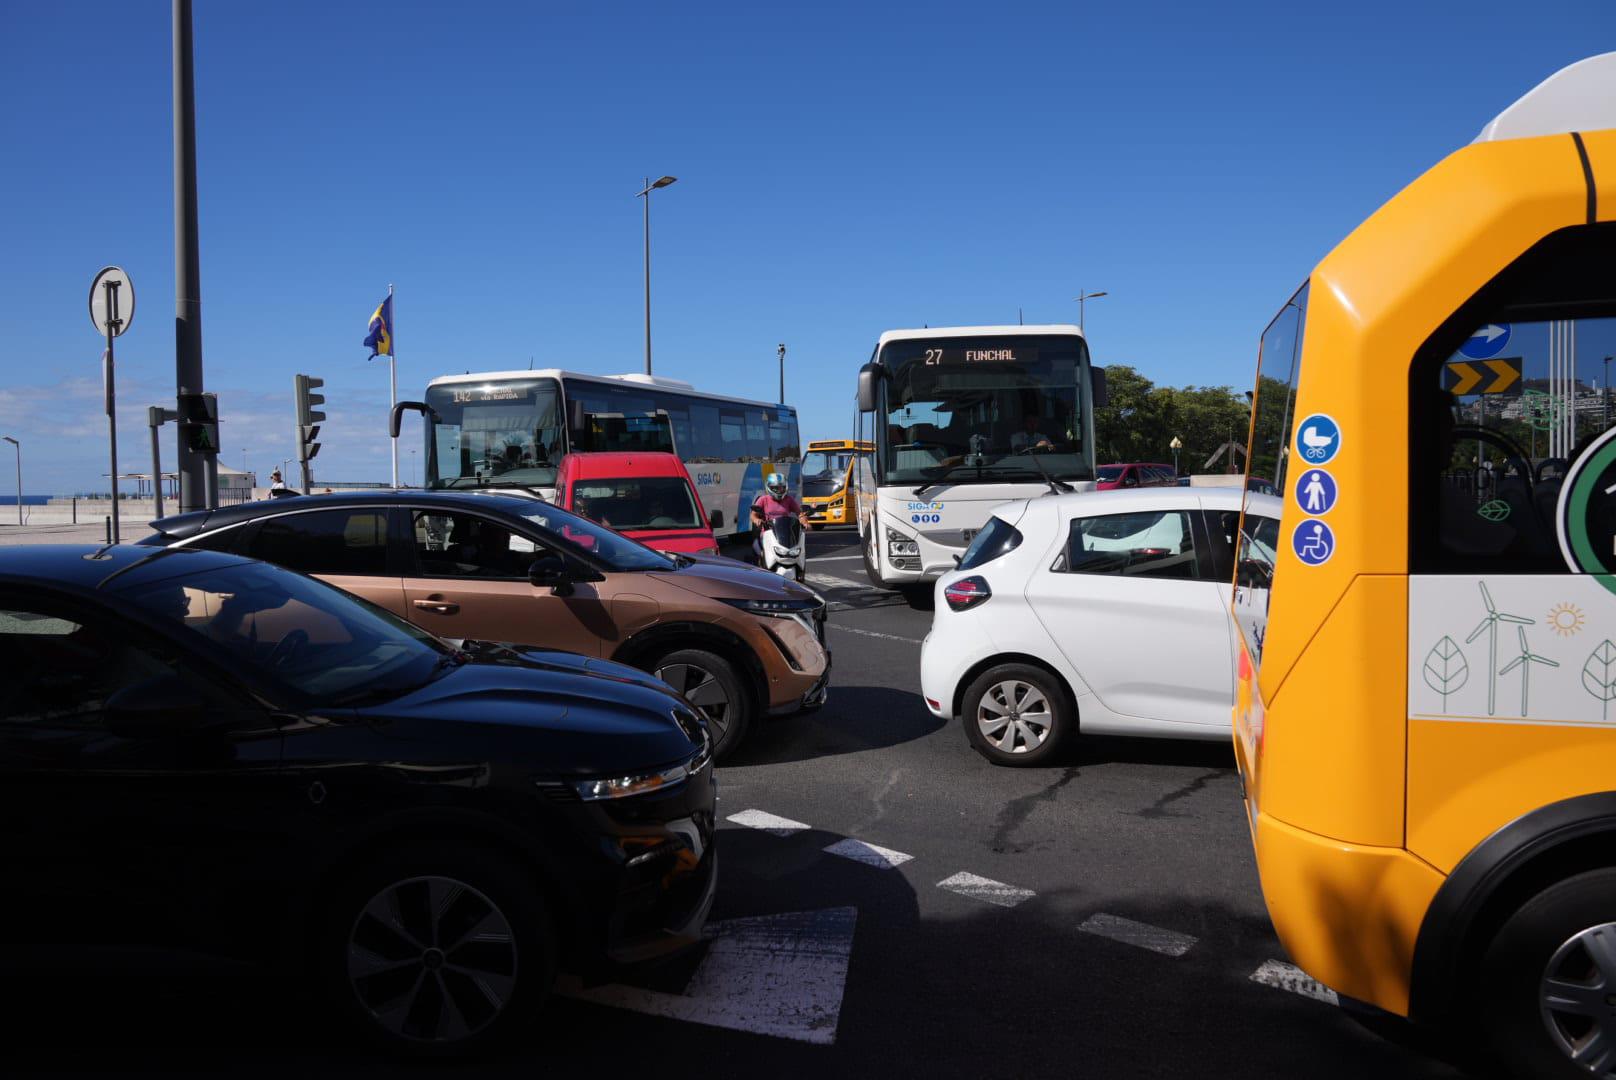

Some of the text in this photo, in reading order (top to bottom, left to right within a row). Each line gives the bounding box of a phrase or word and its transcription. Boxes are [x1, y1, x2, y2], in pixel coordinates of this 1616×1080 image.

[925, 349, 1016, 365] 27 FUNCHAL
[453, 390, 472, 403] 142
[697, 472, 713, 486] SIGA
[908, 502, 930, 511] SIGA
